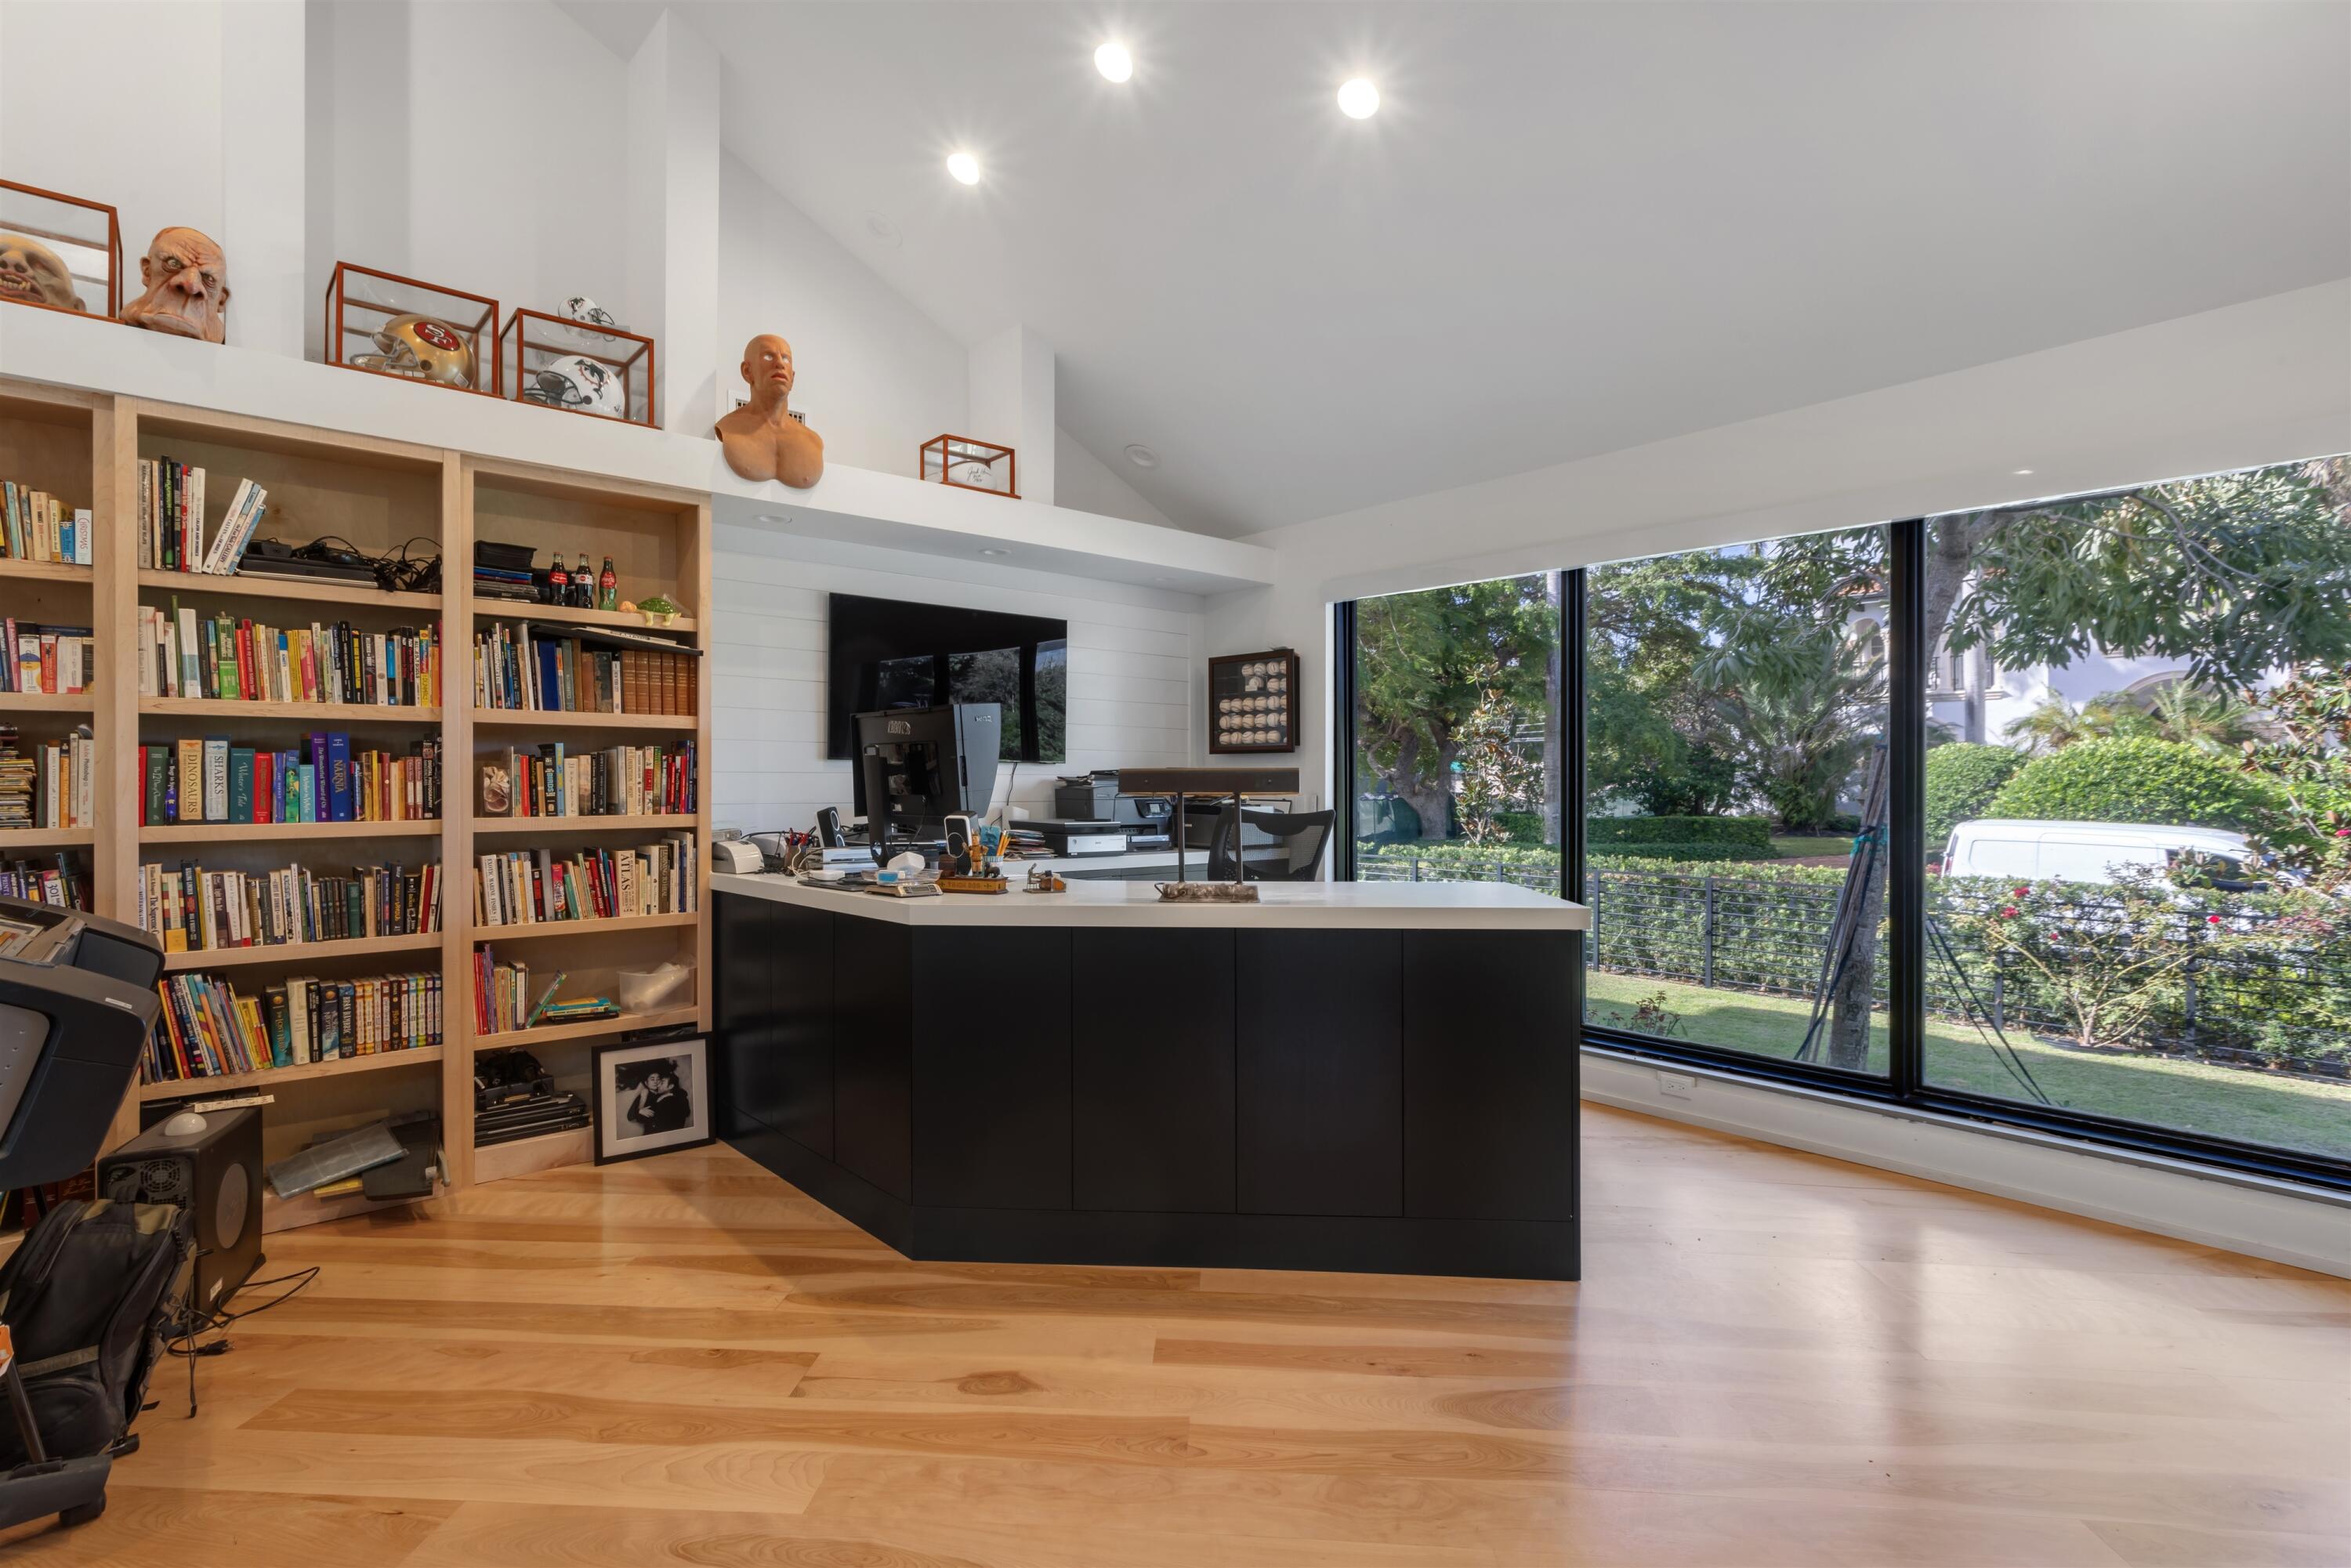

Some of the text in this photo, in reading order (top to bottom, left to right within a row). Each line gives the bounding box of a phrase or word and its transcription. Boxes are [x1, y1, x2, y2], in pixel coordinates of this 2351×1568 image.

[78, 518, 90, 549] CHRISTMAS
[221, 519, 233, 535] CALVIN
[219, 543, 233, 563] GALLERY
[187, 755, 197, 813] DINOSAURS
[214, 755, 224, 795] SHARKS
[237, 762, 248, 807] Winter's Tale
[332, 760, 344, 793] NARNIA
[621, 854, 631, 890] ATLAS
[45, 883, 60, 897] 301
[150, 896, 158, 907] The
[149, 907, 158, 929] Supreme
[342, 997, 351, 1010] BRAN
